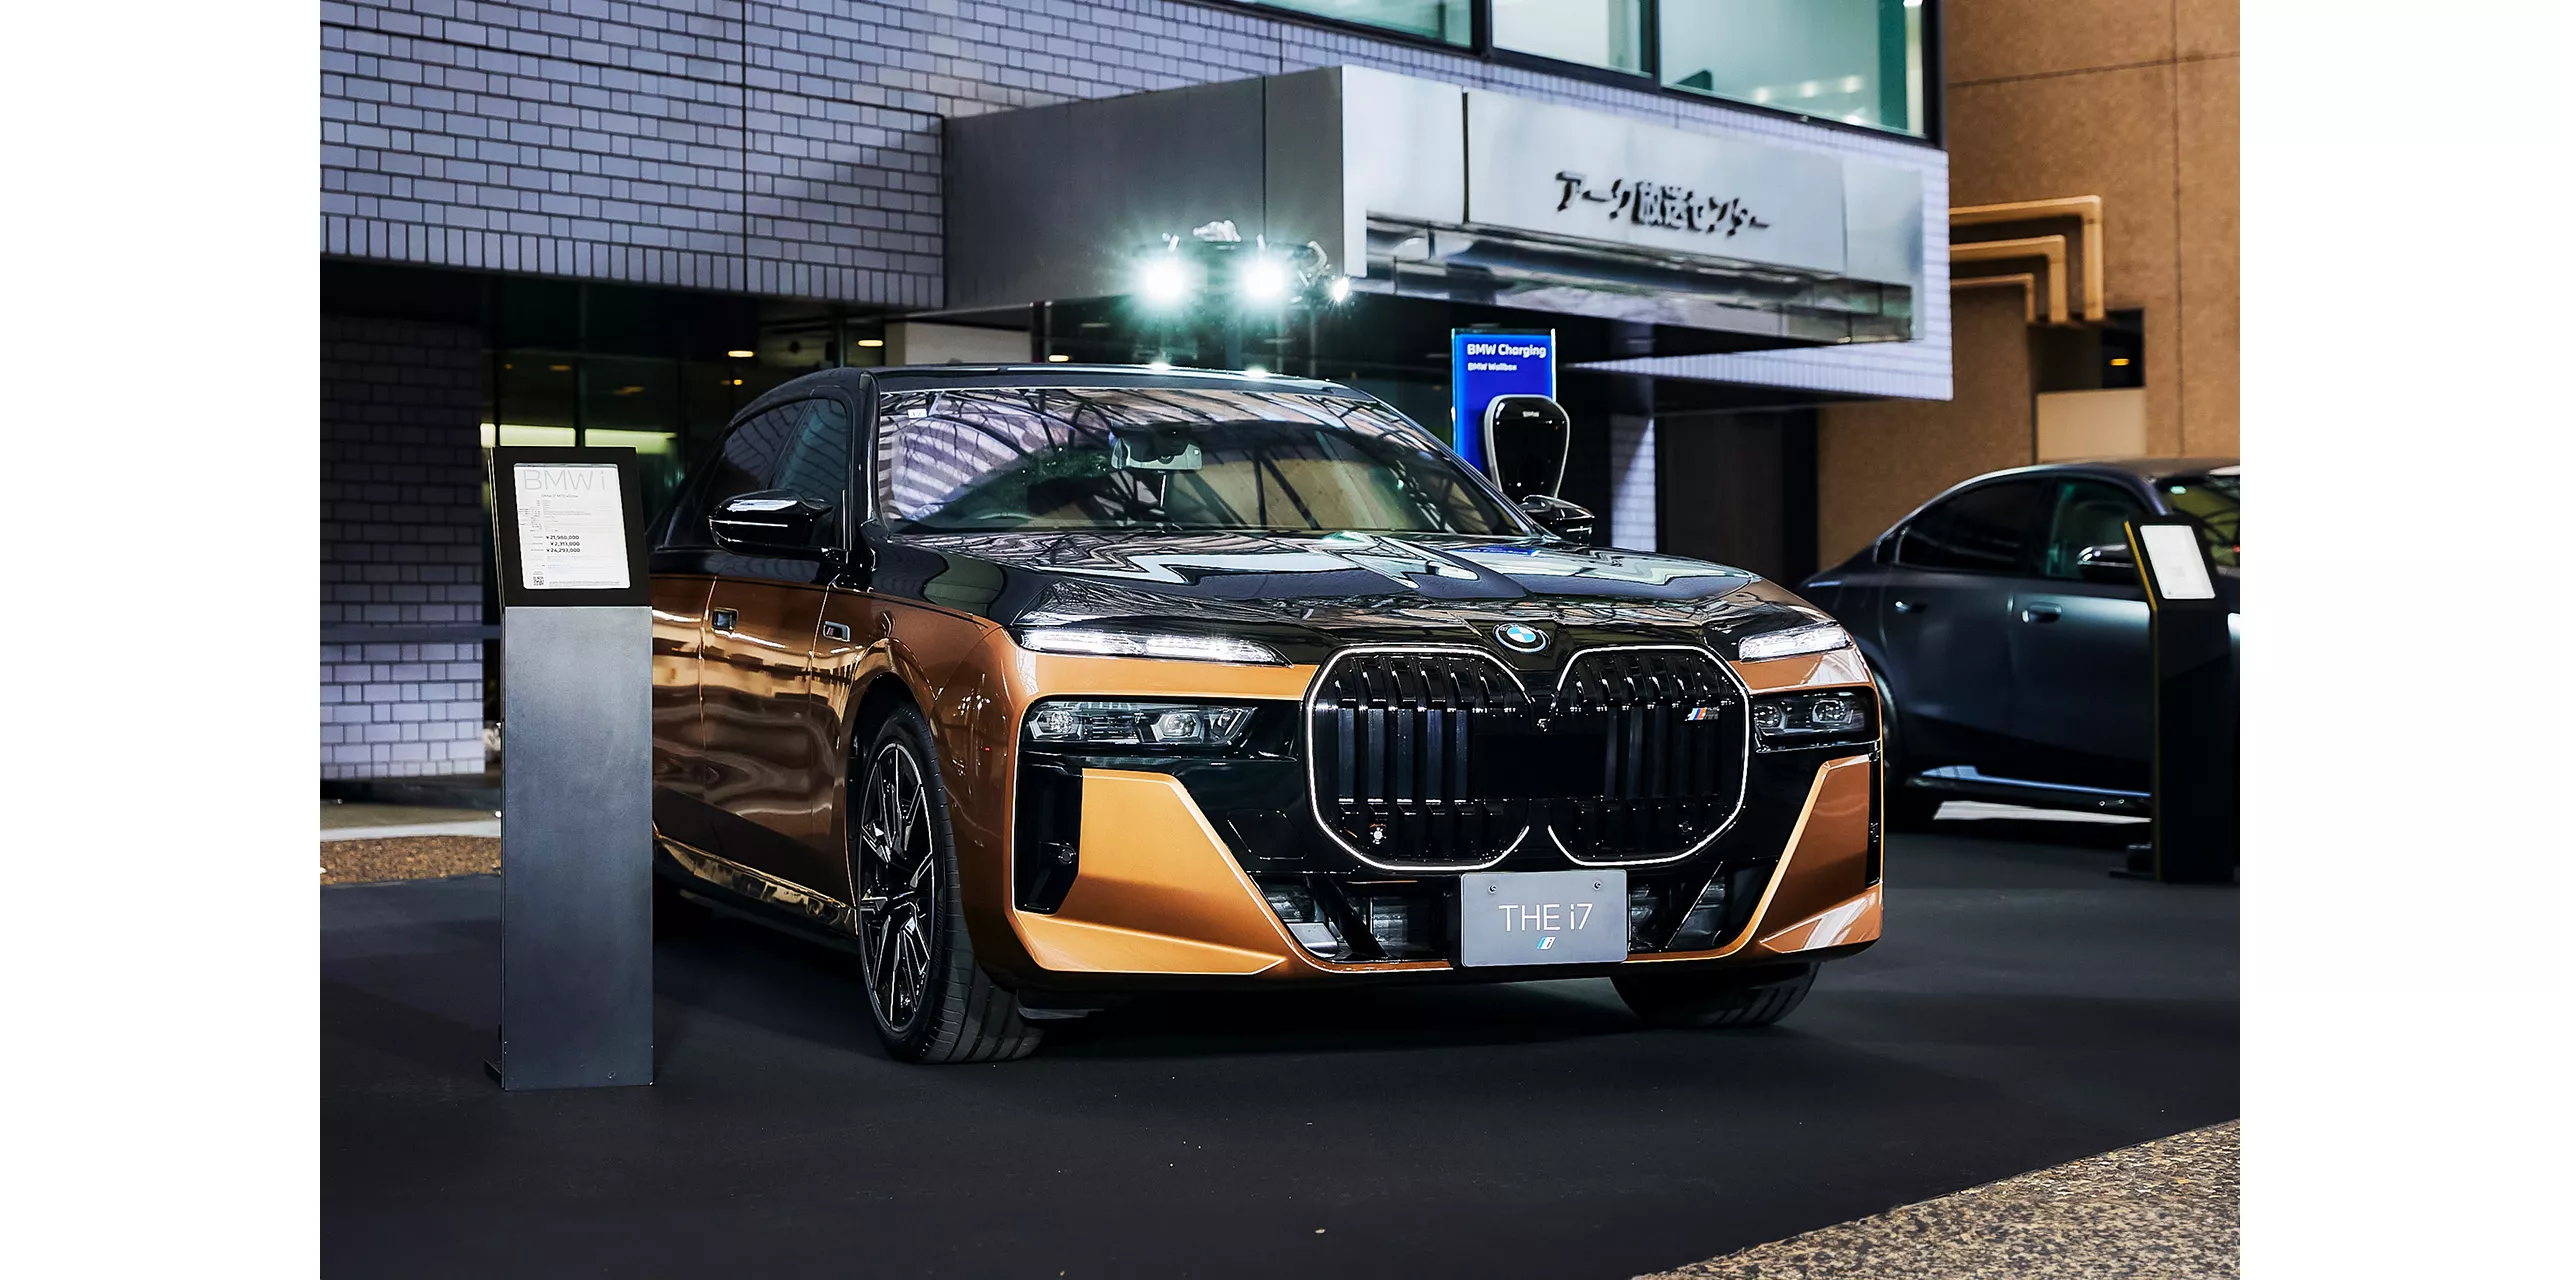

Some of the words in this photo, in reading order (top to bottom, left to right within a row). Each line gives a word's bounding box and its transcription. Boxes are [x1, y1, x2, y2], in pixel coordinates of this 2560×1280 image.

[1555, 171, 1771, 237] アーク放送センター
[1467, 343, 1497, 355] BMW
[1498, 344, 1547, 359] Charging
[1467, 362, 1487, 371] BMW
[1488, 362, 1518, 371] Wallbox
[523, 469, 593, 490] BMW
[600, 470, 606, 491] i
[1498, 903, 1560, 932] THE
[1569, 903, 1594, 931] i7
